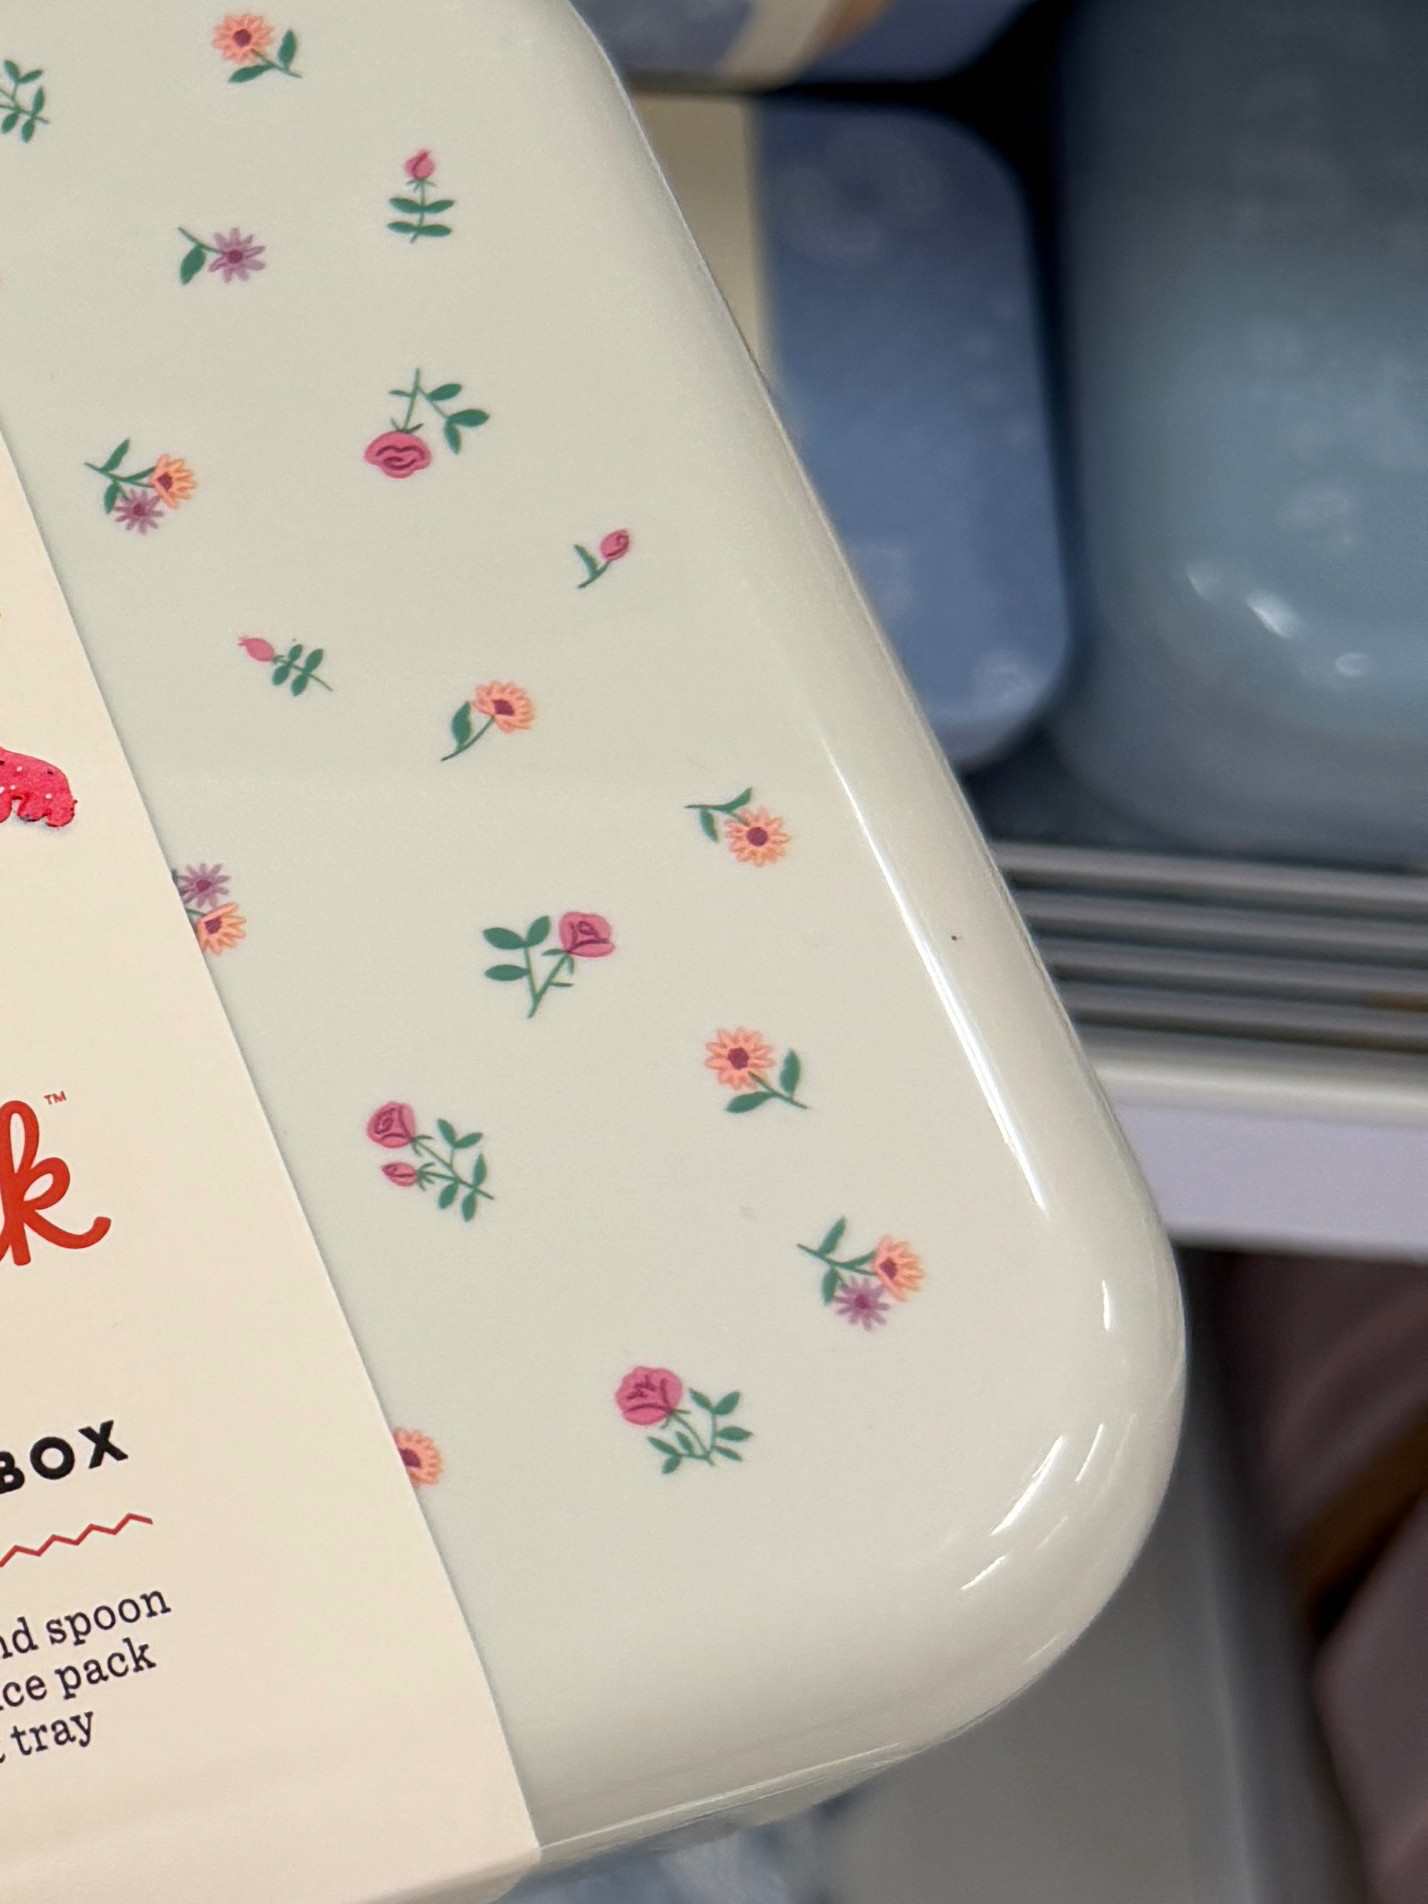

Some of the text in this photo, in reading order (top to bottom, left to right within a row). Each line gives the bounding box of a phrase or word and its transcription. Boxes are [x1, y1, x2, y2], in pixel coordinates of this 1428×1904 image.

[45, 1585, 172, 1651] spoon
[55, 1637, 157, 1699] pack
[8, 1706, 97, 1767] tray
